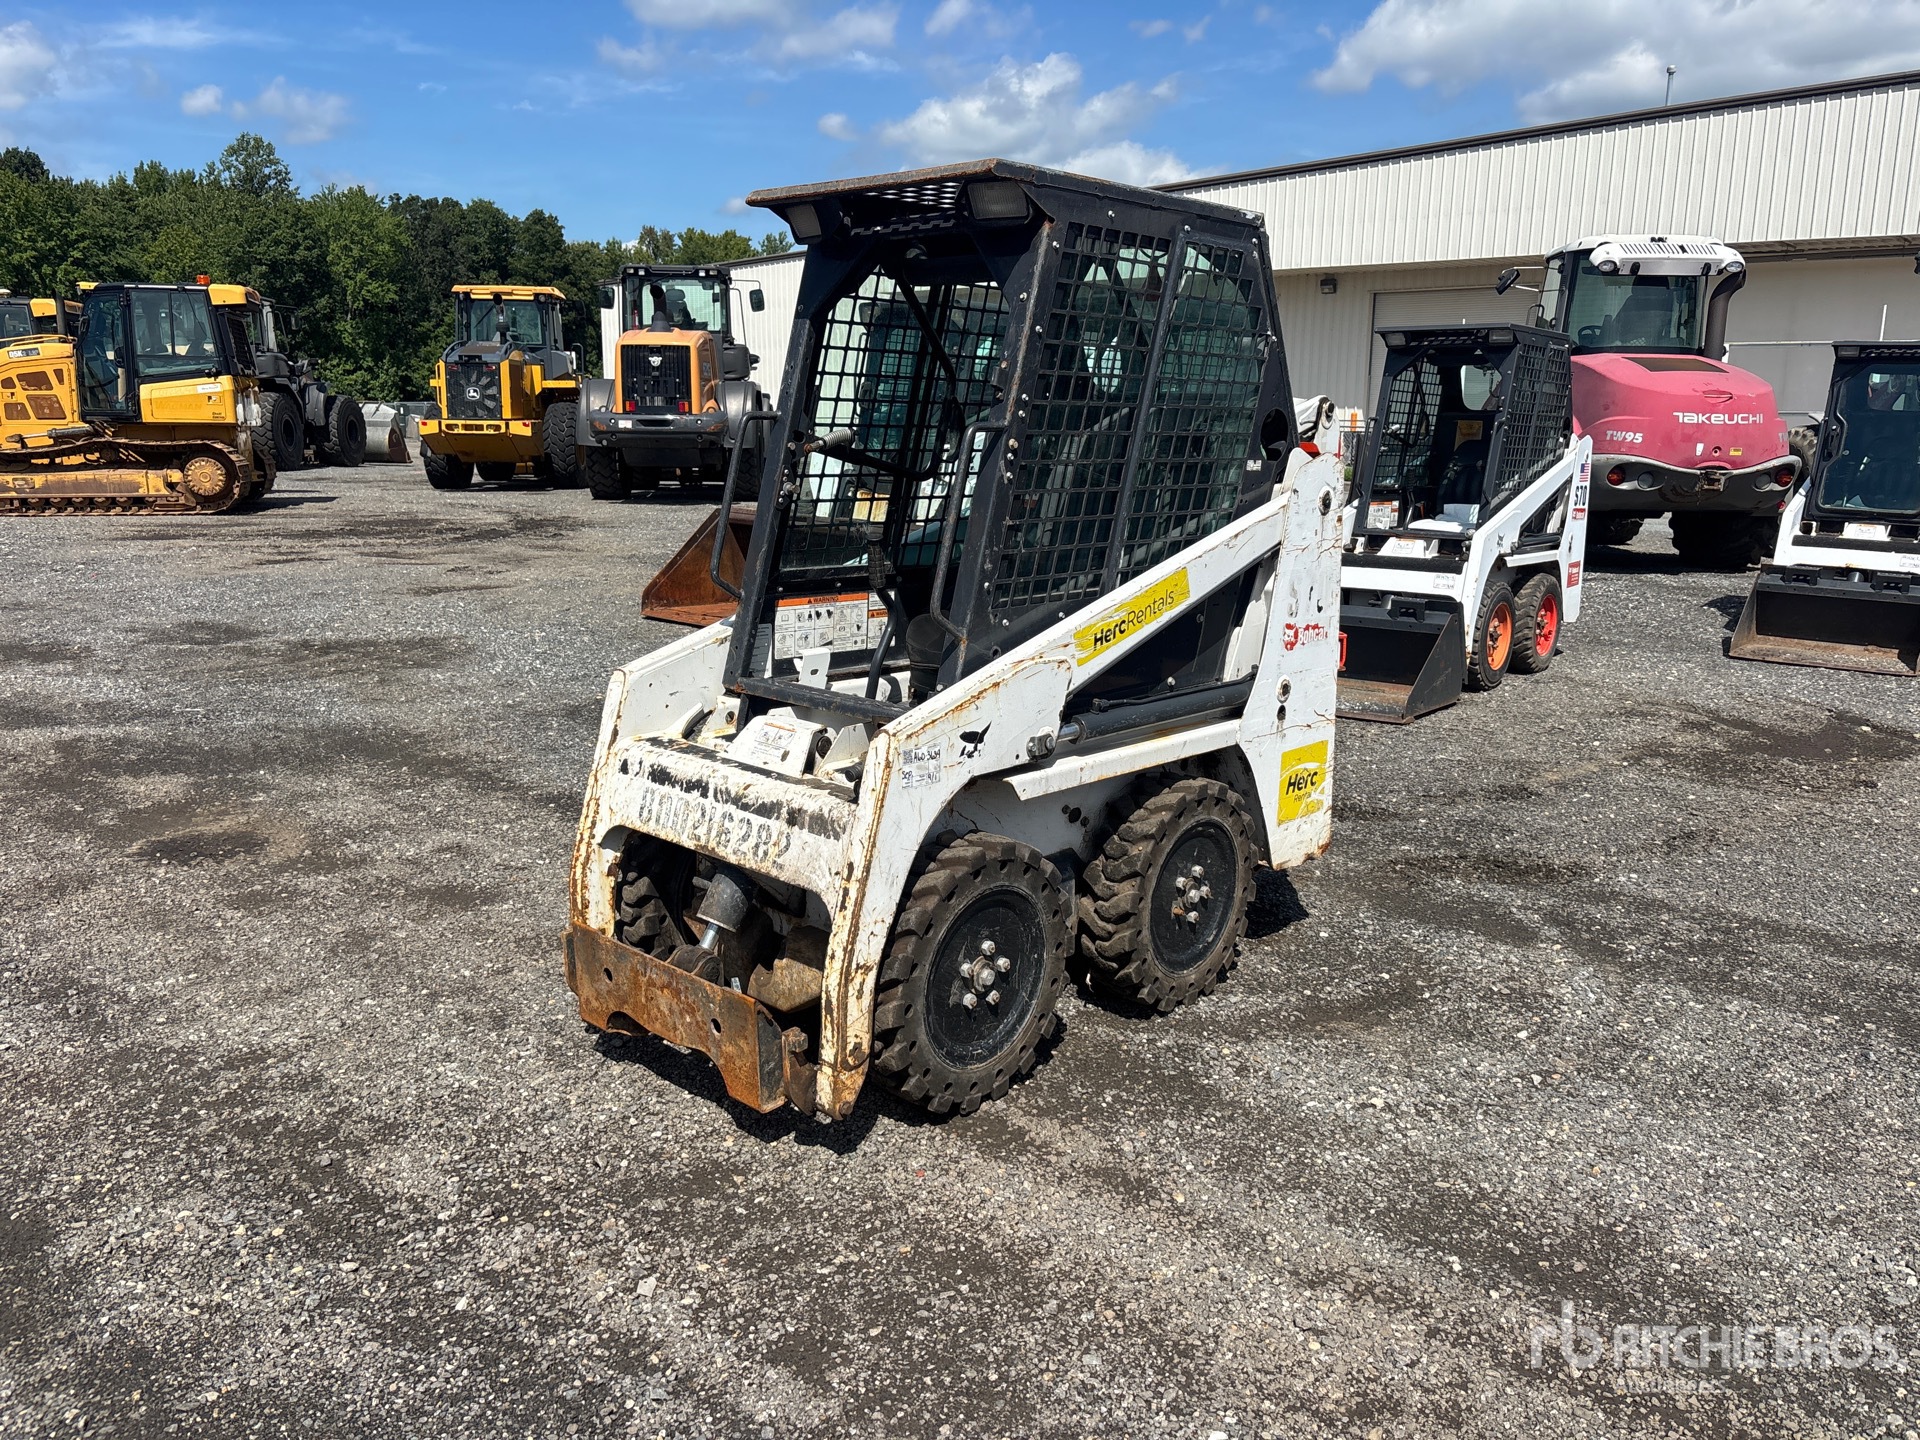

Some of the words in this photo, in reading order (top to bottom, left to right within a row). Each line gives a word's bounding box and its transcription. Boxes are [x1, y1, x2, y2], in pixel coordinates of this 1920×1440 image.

[1672, 411, 1764, 425] TAKEUCHI
[1605, 430, 1643, 443] TW95
[1574, 485, 1588, 506] S70
[813, 595, 839, 604] WARNING
[1285, 771, 1318, 795] Herc
